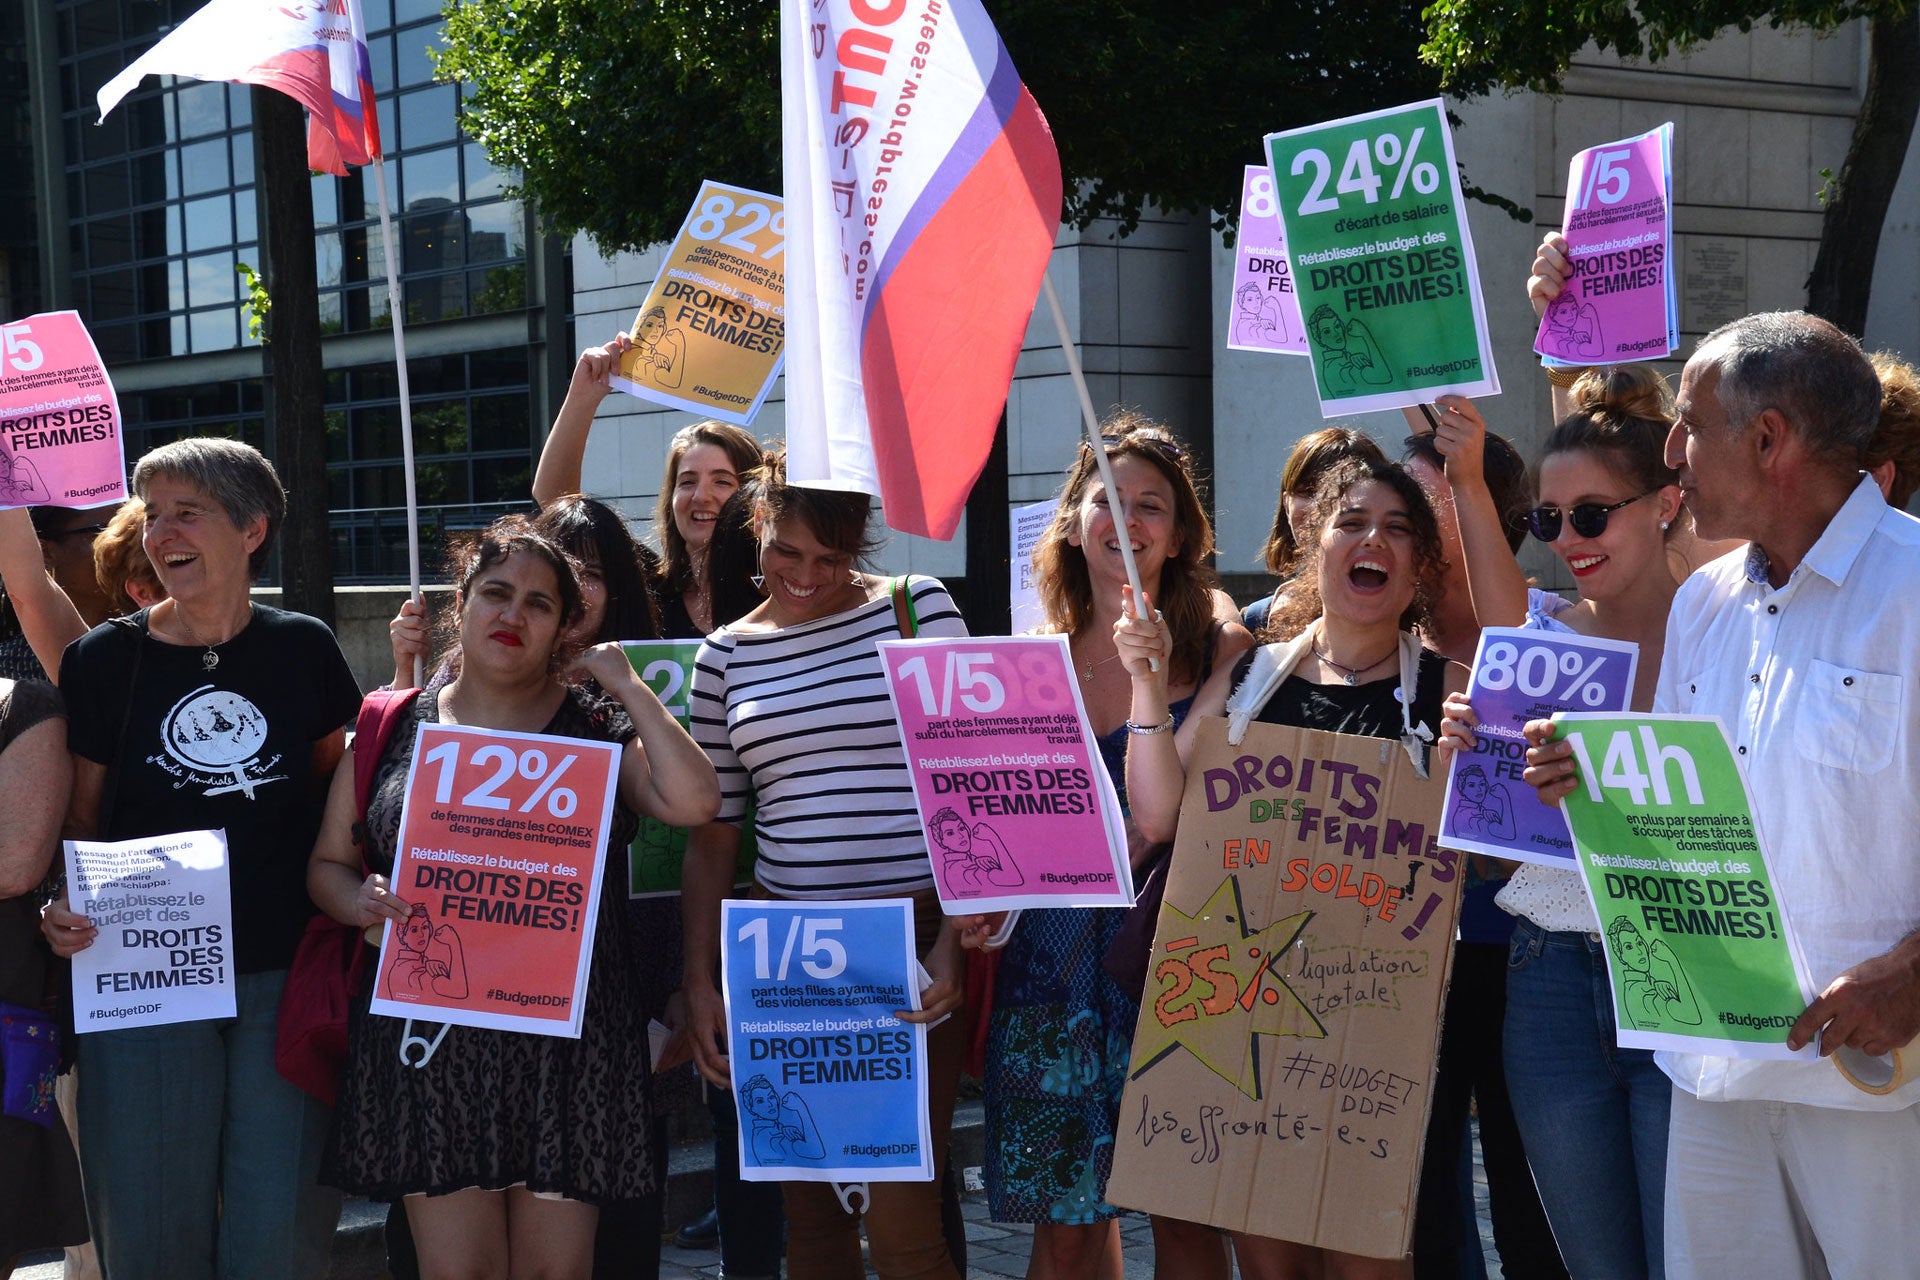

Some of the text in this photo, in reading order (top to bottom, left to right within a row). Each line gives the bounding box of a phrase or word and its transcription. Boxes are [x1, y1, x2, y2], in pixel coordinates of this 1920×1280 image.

[1290, 127, 1440, 217] 24%
[1246, 175, 1277, 218] 8
[1335, 203, 1448, 233] d'écart de salaire
[1587, 204, 1633, 219] des femmes
[1298, 231, 1446, 266] Rétablissez le budget des
[1612, 232, 1659, 248] budget des
[695, 246, 769, 276] des personnes
[1630, 243, 1664, 267] DES
[686, 254, 719, 267] partiel
[720, 262, 744, 277] sont
[744, 271, 763, 285] des
[1310, 255, 1404, 291] DROITS
[1407, 246, 1460, 276] DES
[662, 280, 746, 323] DROITS
[732, 287, 772, 310] budget
[1696, 337, 1747, 353] #BudgetDDF
[4, 377, 20, 385] des
[21, 371, 56, 382] femmes
[58, 367, 80, 376] ayant
[1406, 358, 1478, 378] #BudgetDDF
[78, 379, 105, 389] travail
[693, 384, 752, 405] #BudgetDDF
[45, 394, 102, 409] budget des
[0, 404, 112, 433] ROITS DES
[64, 482, 121, 498] #BudgetDDF
[897, 651, 1006, 717] 1/5
[1477, 642, 1607, 707] 80%
[915, 724, 1080, 740] subi du harcèlement sexuel au
[928, 714, 1077, 732] part des femmes ayant déjà
[1047, 734, 1082, 744] travail
[918, 752, 1076, 769] Rétablissez le budget des
[1566, 725, 1705, 806] 14h
[424, 741, 579, 818] 12%
[931, 768, 1090, 794] DROITS DES
[1203, 755, 1381, 820] DROITS
[1250, 799, 1306, 823] DES
[1627, 814, 1749, 828] en plus par semaine à
[430, 811, 593, 838] de femmes dans les COMEX
[449, 823, 591, 848] des grandes entreprises
[1632, 826, 1753, 840] s'occuper des tâches
[75, 850, 118, 859] Message
[128, 844, 179, 856] l'attention
[1223, 838, 1271, 869] EN
[1298, 807, 1459, 883] FEMMES
[1676, 839, 1757, 853] domestiques
[76, 858, 129, 866] Emmanuel
[411, 847, 577, 877] Rétablissez le budget des
[1590, 854, 1750, 876] Rétablissez le budget des
[415, 865, 584, 906] DROITS DES
[1040, 873, 1114, 885] #BudgetDDF
[1604, 873, 1769, 907] DROITS DES
[84, 892, 205, 913] Rétablissez le
[86, 907, 190, 928] budget des
[122, 925, 223, 948] DROITS
[738, 915, 848, 981] 1/5
[170, 946, 223, 967] DES
[1298, 948, 1421, 986] liquidation
[487, 988, 570, 1008] #BudgetDDF
[751, 985, 904, 999] part des filles ayant subi
[755, 994, 906, 1008] des violences sexuelles
[1312, 978, 1390, 1015] totale
[89, 1004, 162, 1019] #BudgetDDF
[741, 1016, 901, 1033] Rétablissez le budget des
[750, 1031, 912, 1061] DROITS DES
[1282, 1051, 1420, 1105] #BUDGET
[1341, 1095, 1396, 1119] DDF
[1136, 1094, 1178, 1147] les
[842, 1144, 918, 1157] #BudgetDDF
